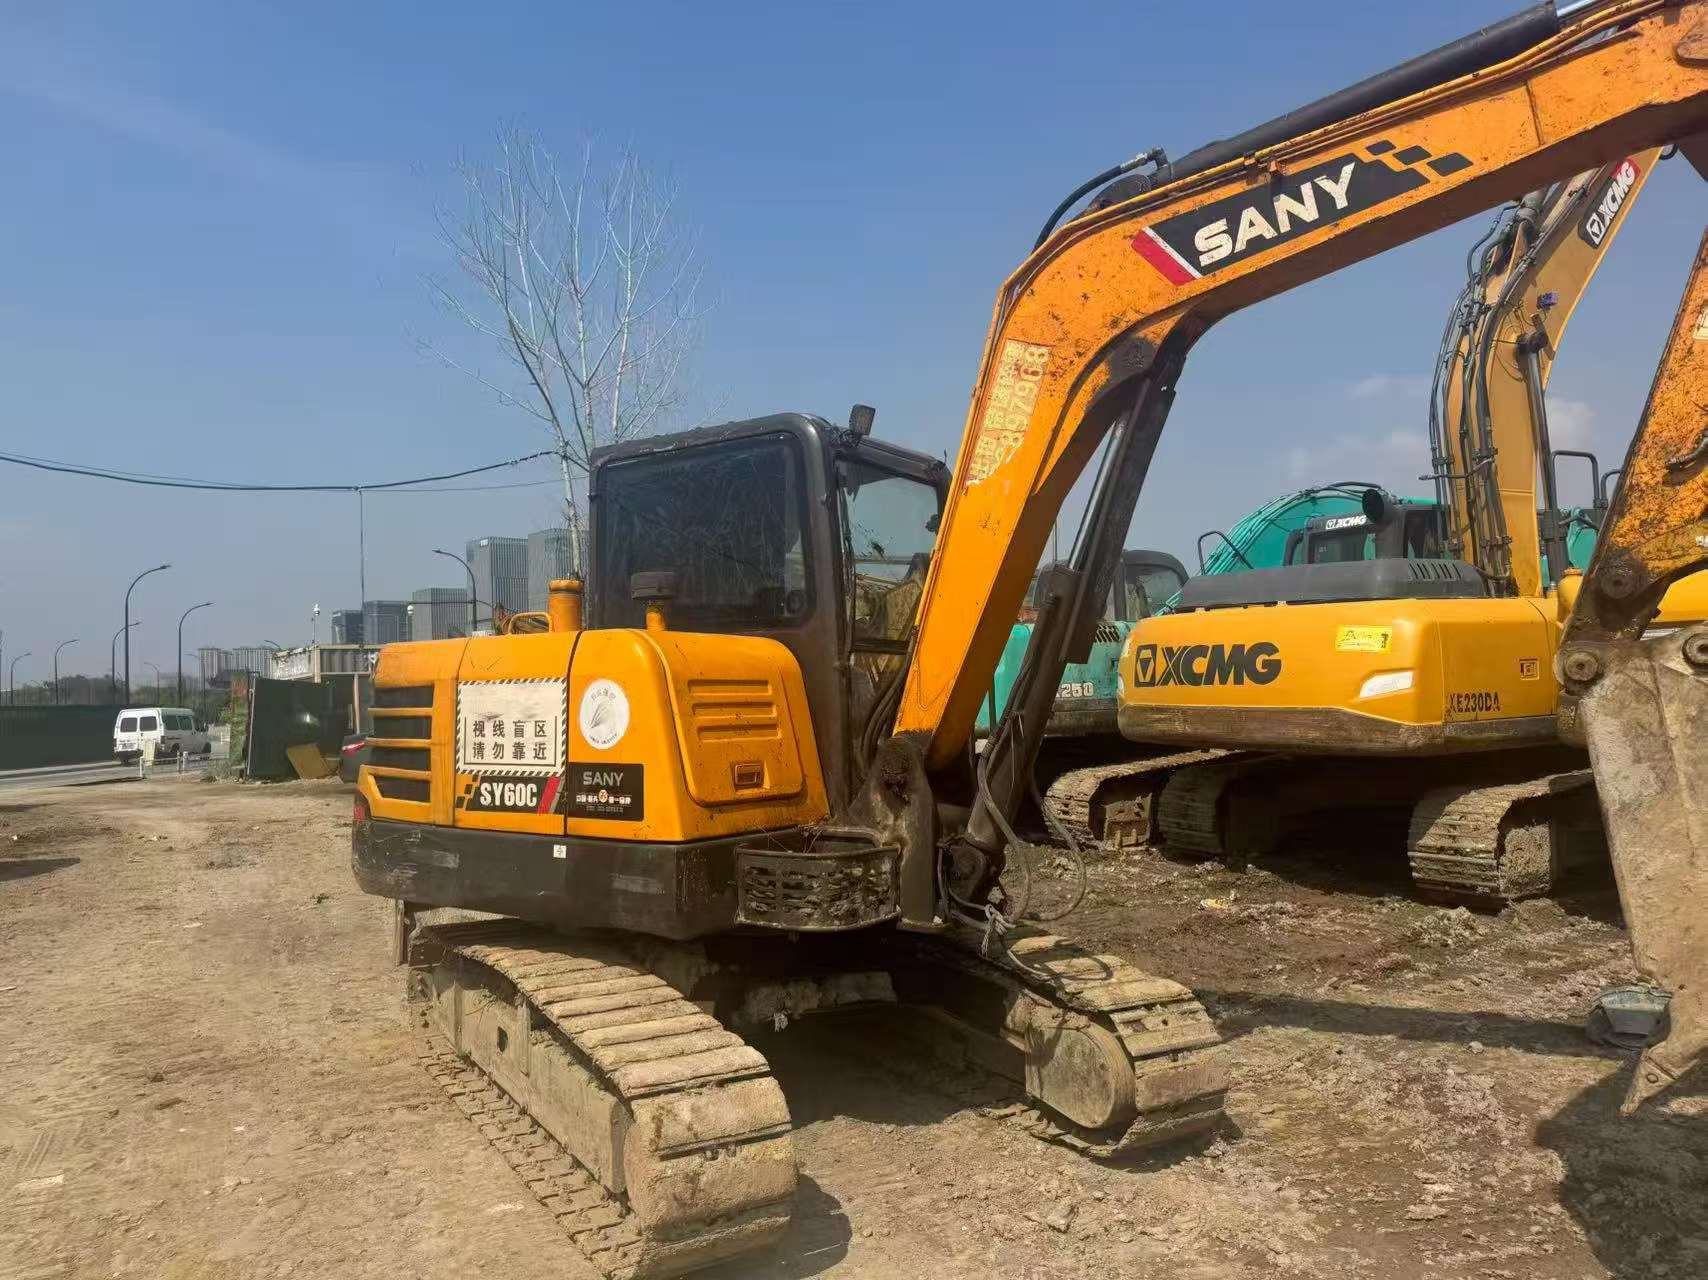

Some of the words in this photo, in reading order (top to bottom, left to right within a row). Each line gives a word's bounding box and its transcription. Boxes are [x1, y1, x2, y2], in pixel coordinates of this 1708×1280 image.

[1598, 161, 1635, 227] XCMG
[1194, 161, 1355, 267] SANY
[1155, 641, 1282, 686] XCMG
[1056, 682, 1094, 698] 250
[1450, 691, 1501, 713] XE230DA
[472, 719, 547, 739] 视线盲区
[472, 741, 547, 761] 请勿靠近
[583, 771, 624, 786] SANY
[480, 782, 537, 807] SY60C
